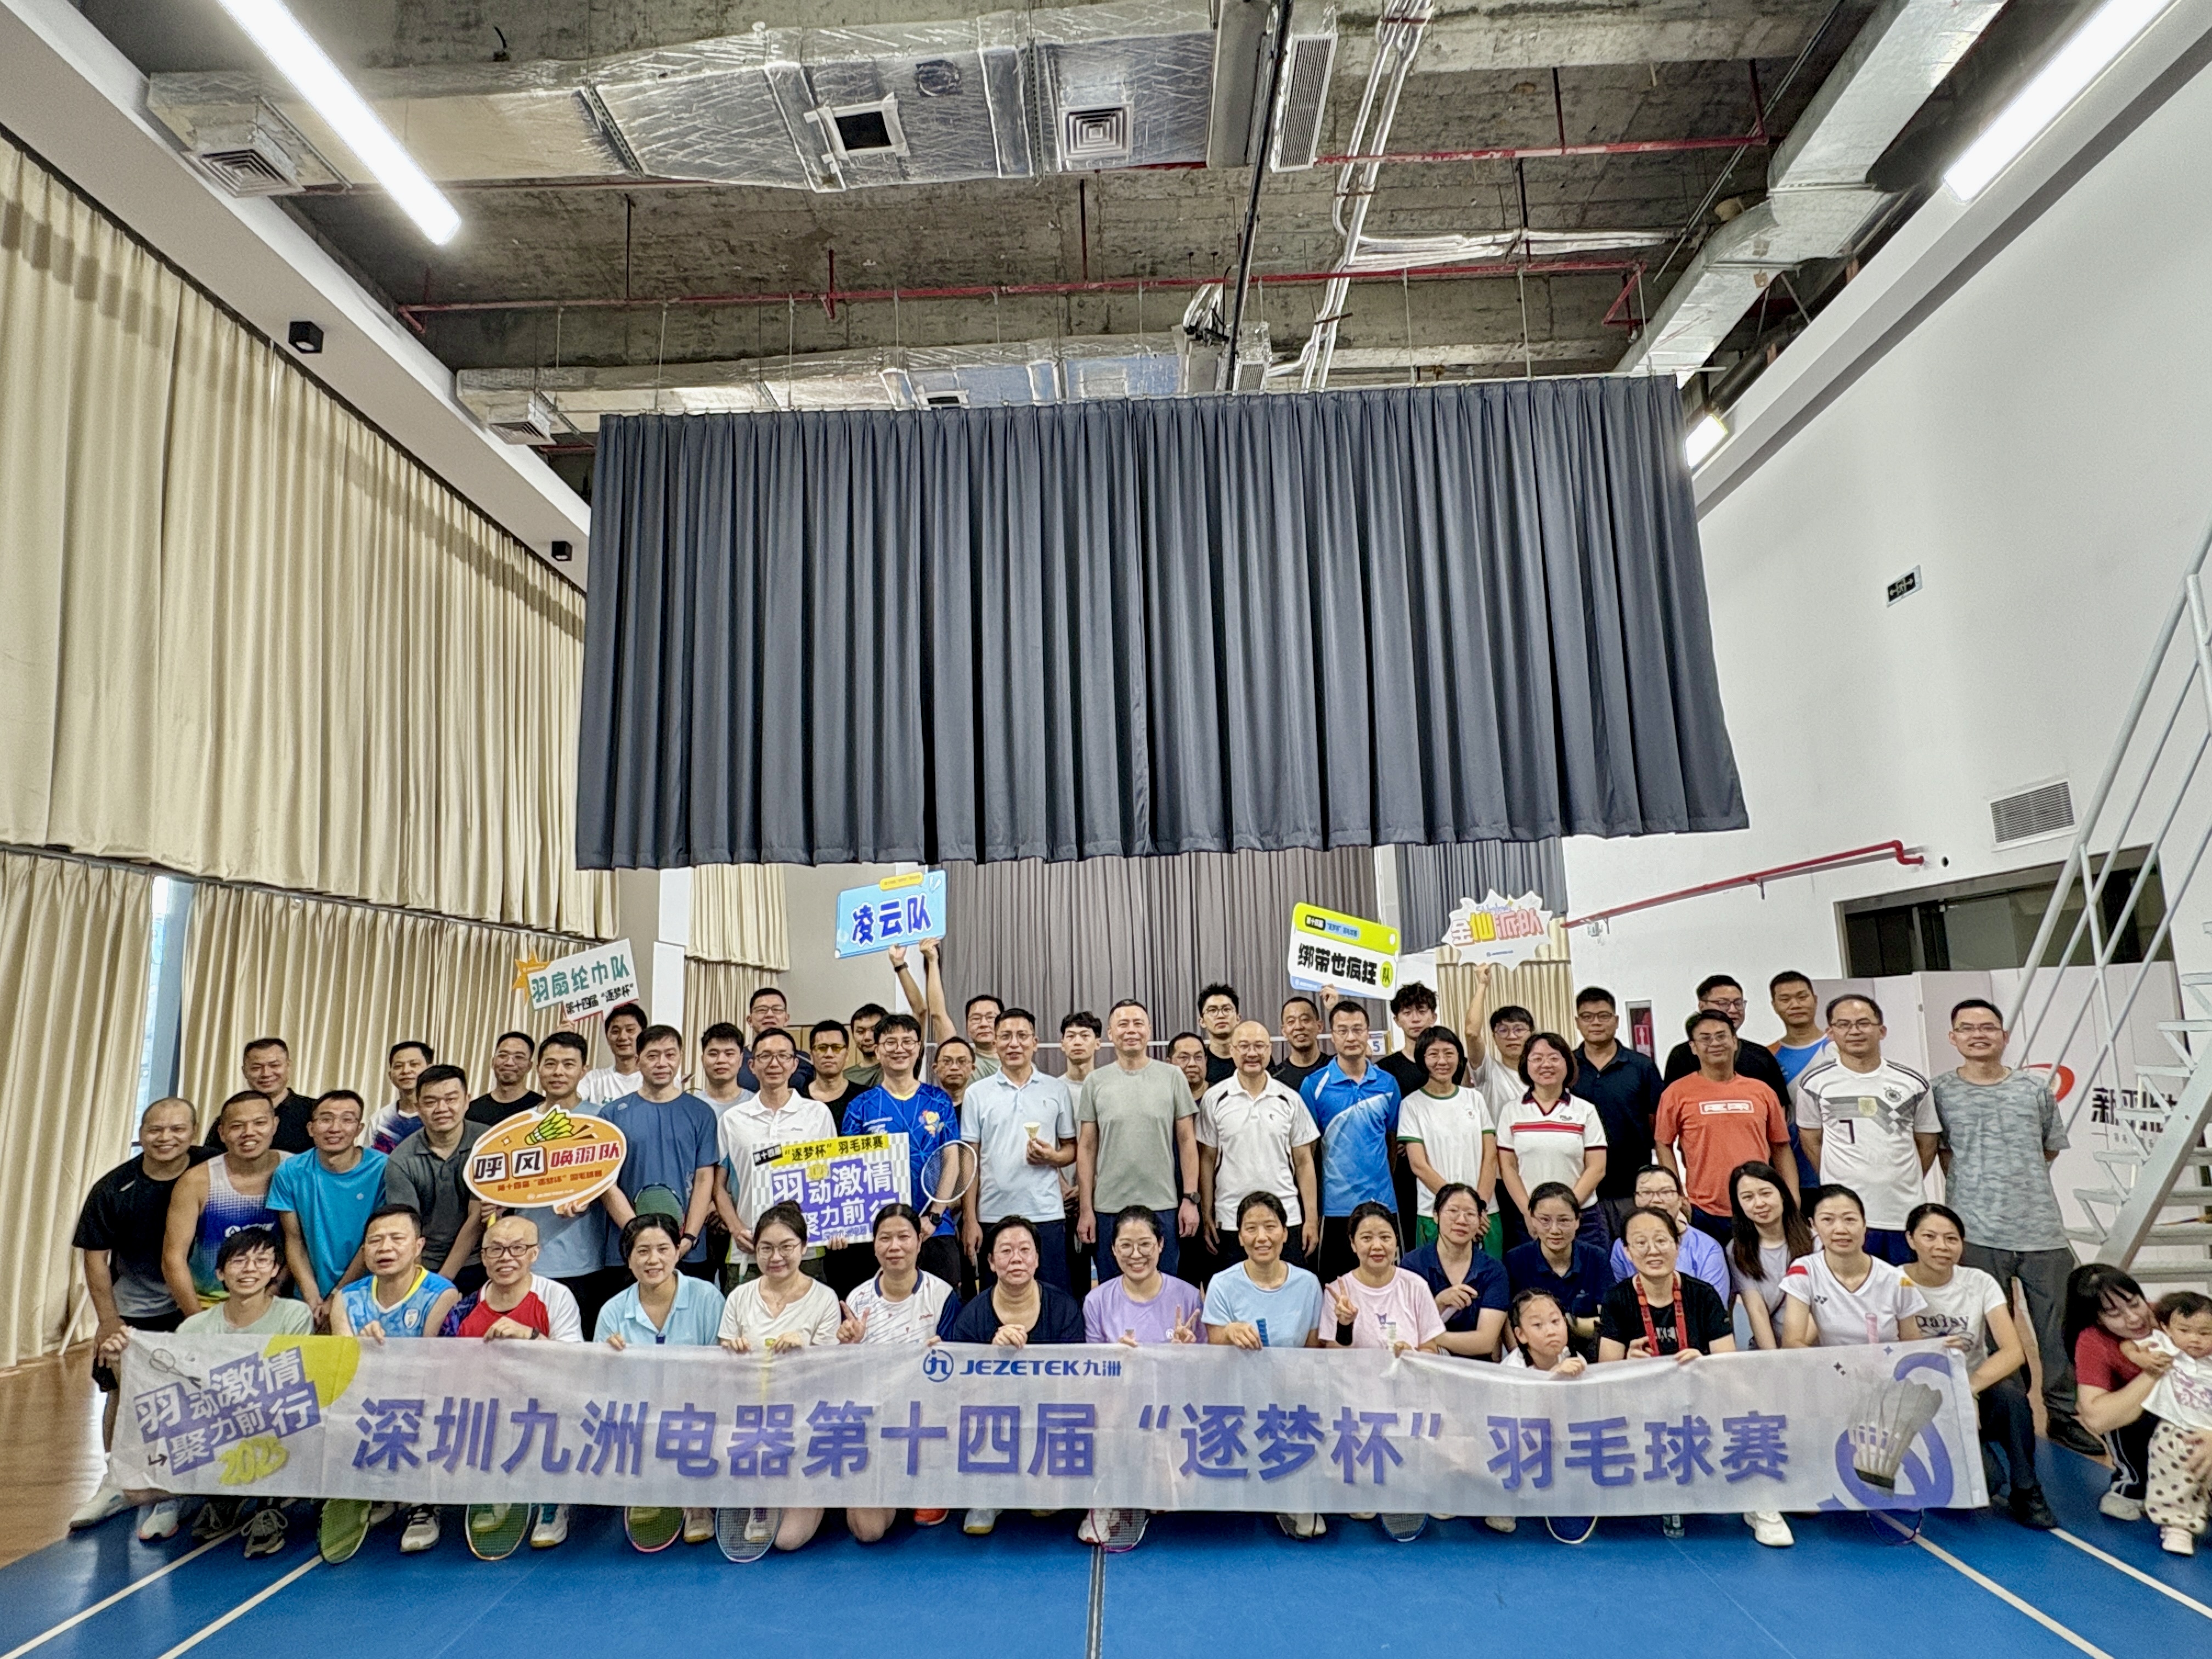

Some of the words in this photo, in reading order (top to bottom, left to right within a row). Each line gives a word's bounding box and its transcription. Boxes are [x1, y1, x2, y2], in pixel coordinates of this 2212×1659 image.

[851, 895, 932, 944] 凌云队
[531, 954, 630, 1003] 羽扇纶巾队
[1297, 943, 1378, 985] 绑带也疯狂
[1373, 1040, 1380, 1052] 5
[1838, 1119, 1855, 1144] 7
[473, 1142, 620, 1179] 呼风唤羽队
[773, 1160, 893, 1204] 羽动激情
[960, 1359, 1080, 1376] JEZETEK
[136, 1349, 301, 1435] 羽动激情
[169, 1389, 313, 1470] 聚力前行
[218, 1435, 290, 1486] 2025
